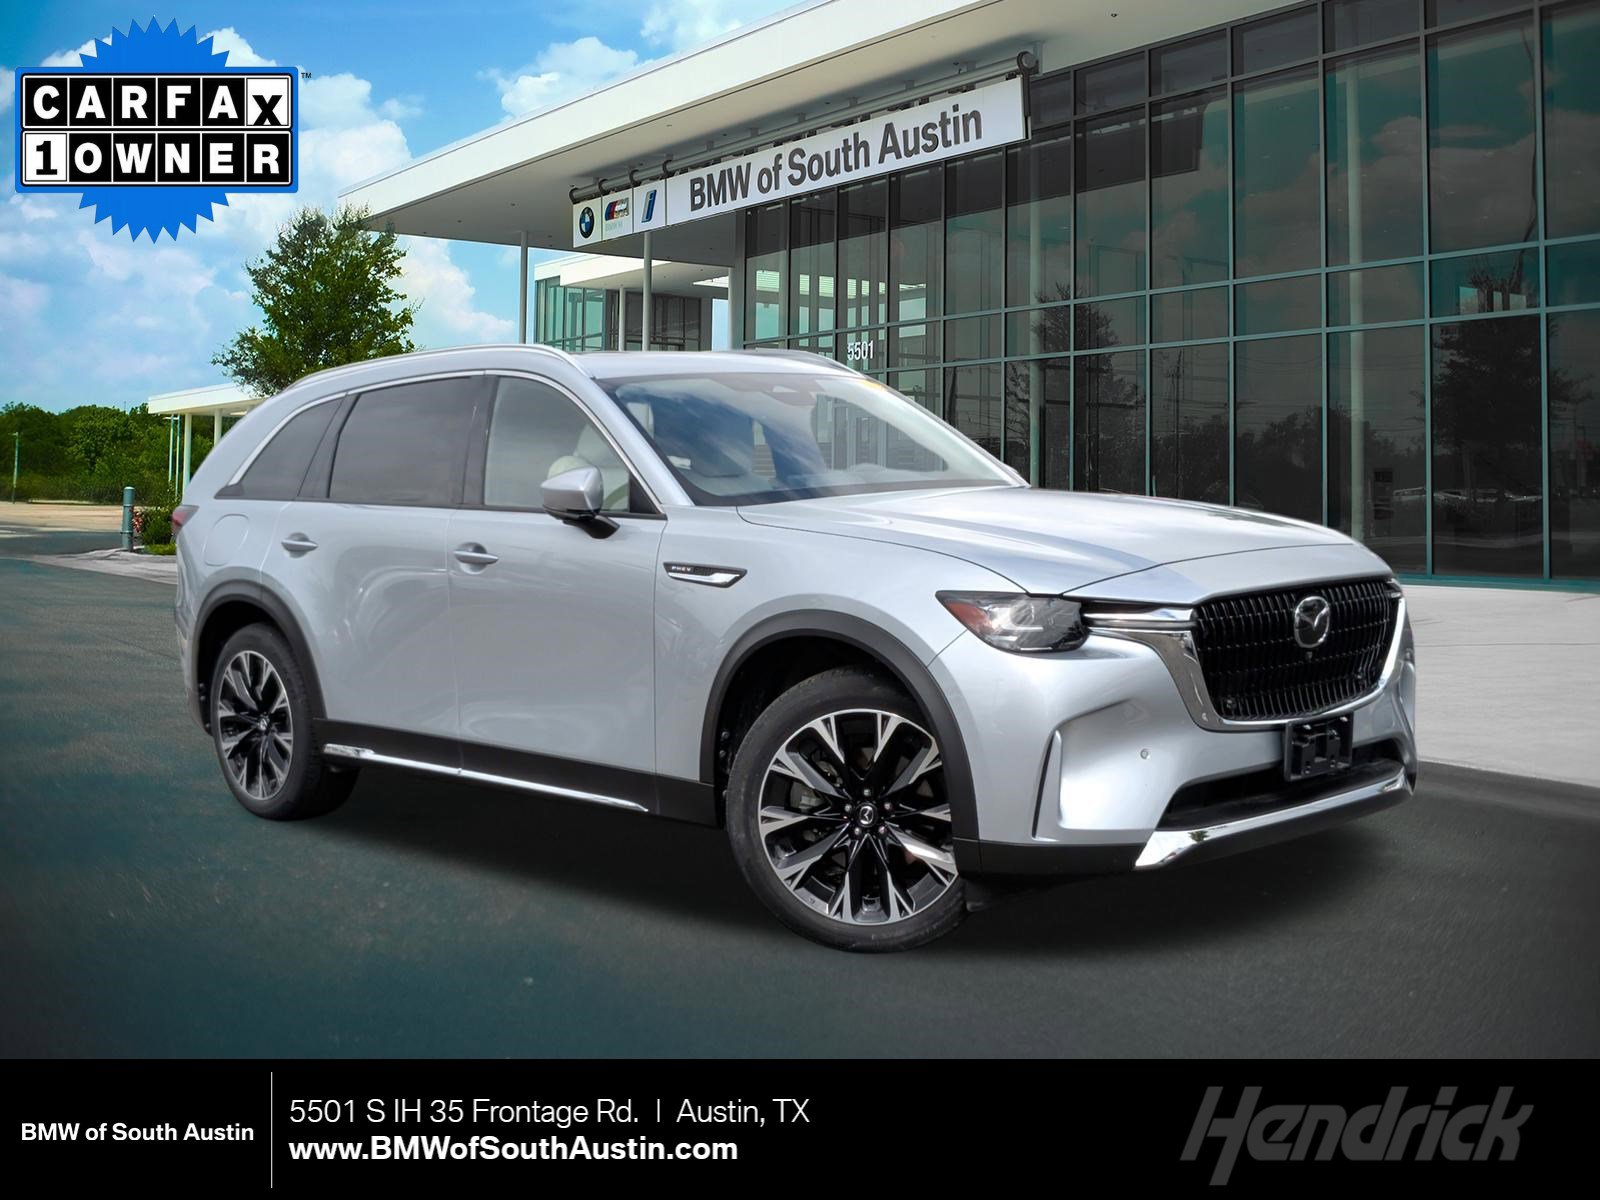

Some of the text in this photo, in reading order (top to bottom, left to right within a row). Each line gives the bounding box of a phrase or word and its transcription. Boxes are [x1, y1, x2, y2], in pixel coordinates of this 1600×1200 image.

[690, 162, 752, 212] BMW
[757, 152, 783, 194] of
[787, 131, 870, 187] South
[878, 103, 983, 164] Austin
[847, 340, 874, 361] 5501
